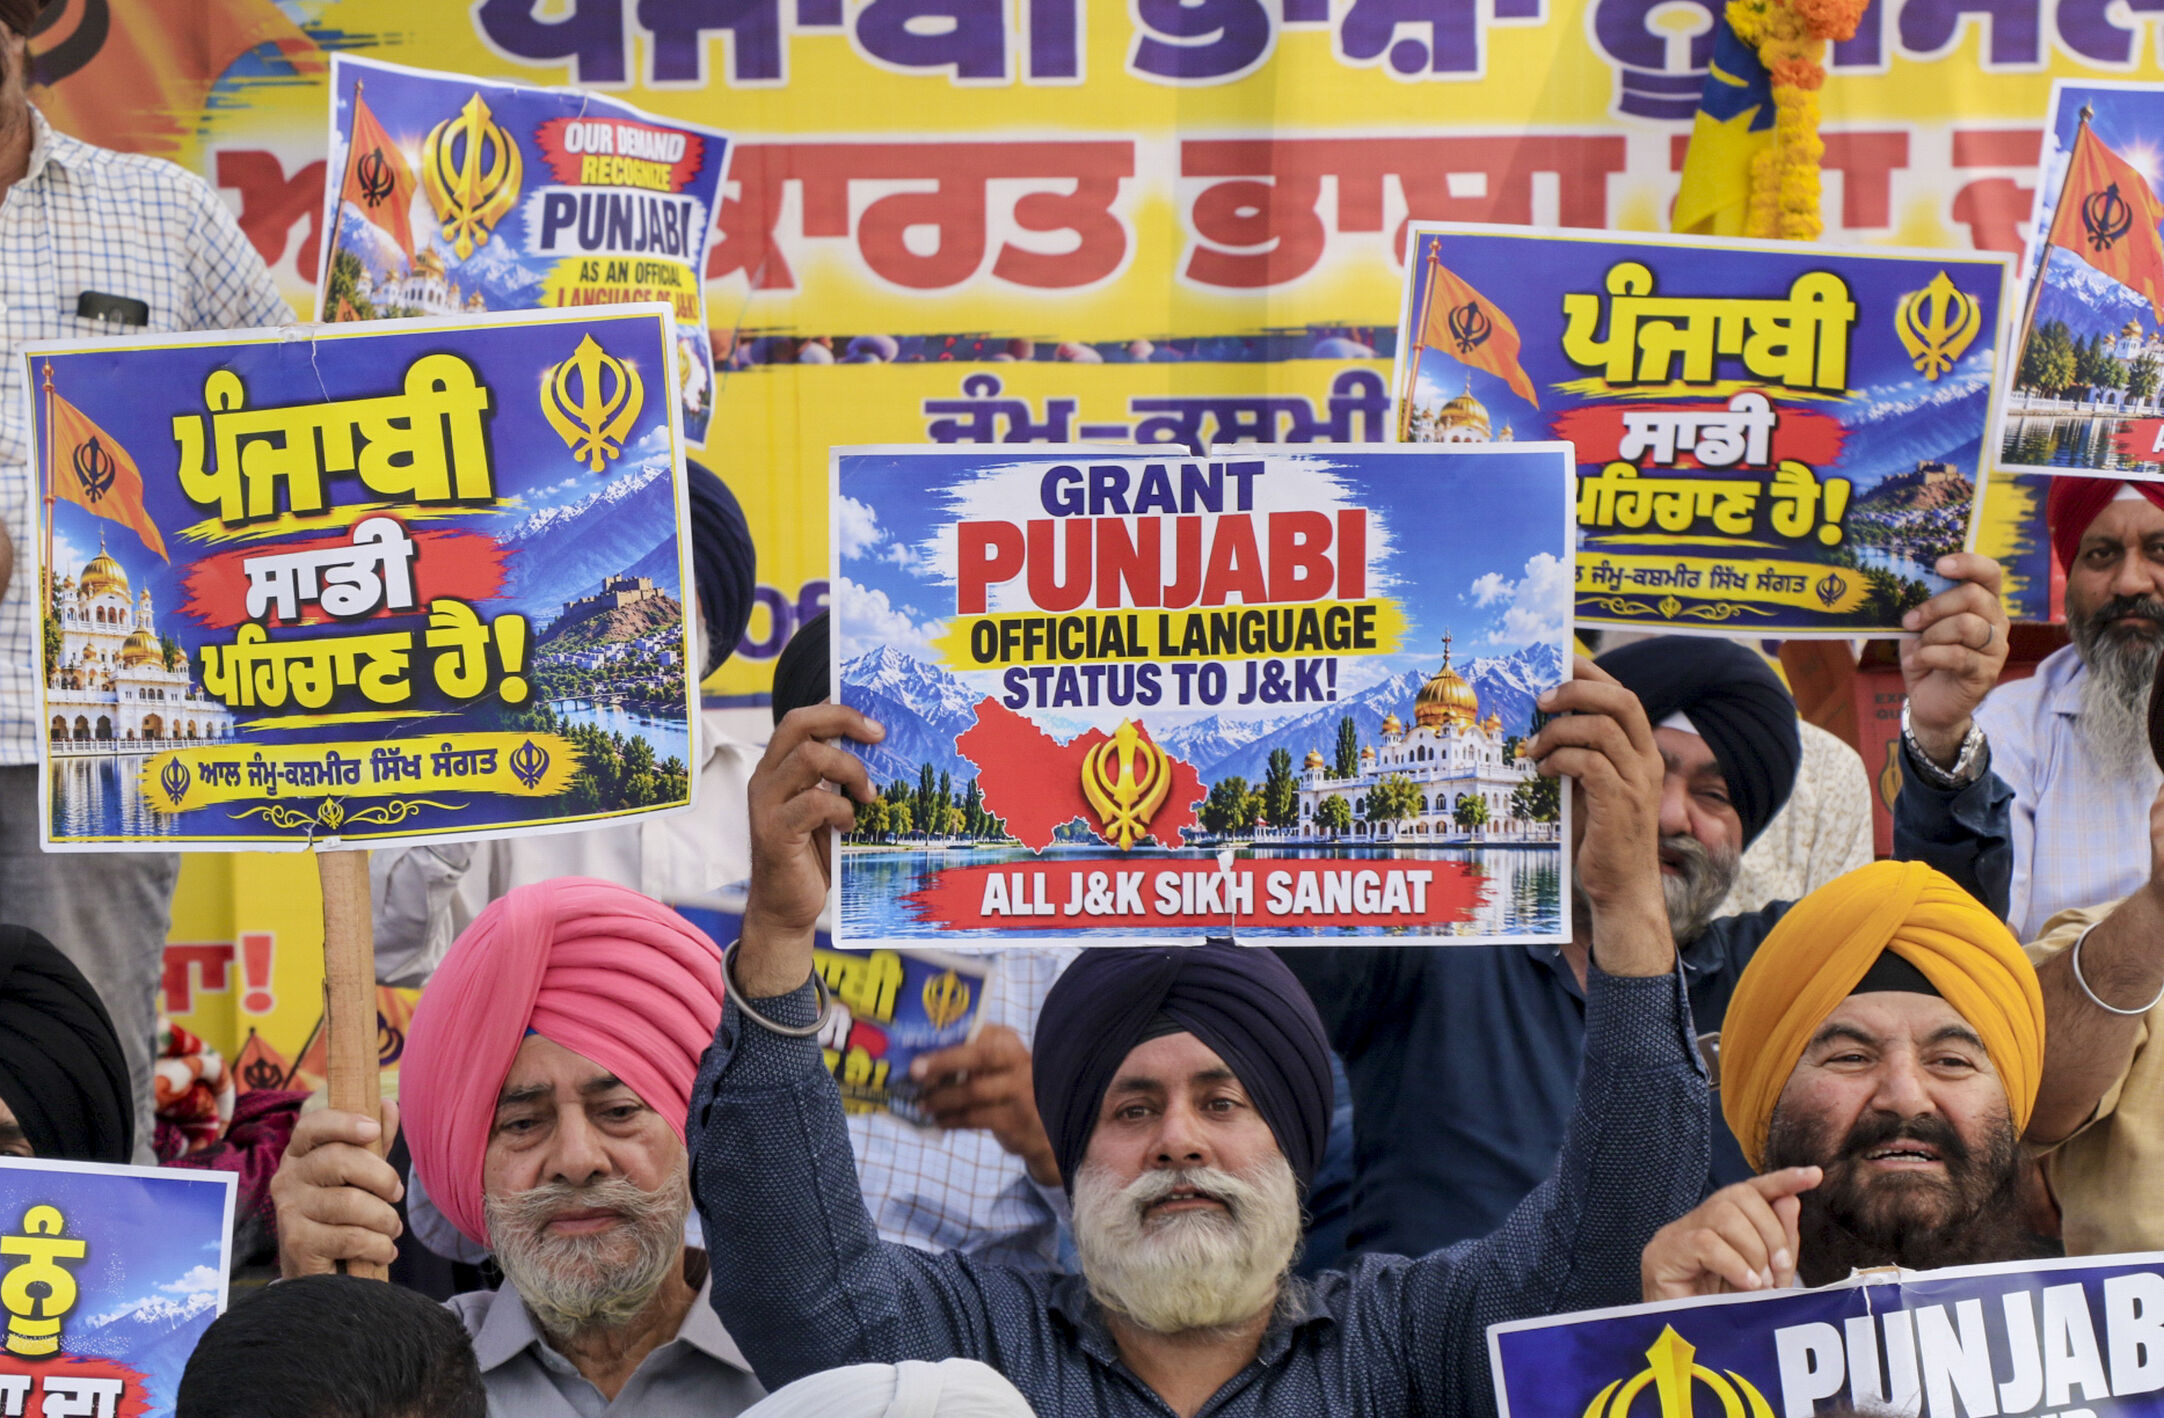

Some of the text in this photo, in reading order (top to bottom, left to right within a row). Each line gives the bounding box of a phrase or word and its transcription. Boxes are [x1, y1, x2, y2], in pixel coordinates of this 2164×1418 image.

[564, 122, 686, 163] OUR DEMAND
[581, 154, 672, 192] RECOGNIZE
[540, 192, 692, 258] PUNJABI
[579, 261, 681, 287] AS AN OFFICIAL
[1562, 262, 1856, 390] ਪੰਜਾਬੀ
[172, 353, 493, 521] ਪੰਜਾਬੀ
[1619, 392, 1776, 466] ਸਾਡੀ
[1040, 461, 1265, 518] GRANT
[243, 516, 414, 620] ਸਾਡੀ
[957, 508, 1368, 615] PUNJABI
[200, 622, 413, 709] ਪਹਿਚਾਣ
[970, 606, 1377, 664] OFFICIAL LANGUAGE
[1003, 658, 1338, 711] STATUS TO J&K!
[370, 747, 422, 784] ਸਿੱਖ
[430, 742, 498, 779] ਸੰਗਤ
[981, 869, 1433, 917] ALL J&K SIKH SANGAT
[1774, 1271, 2164, 1418] PUNJAB
